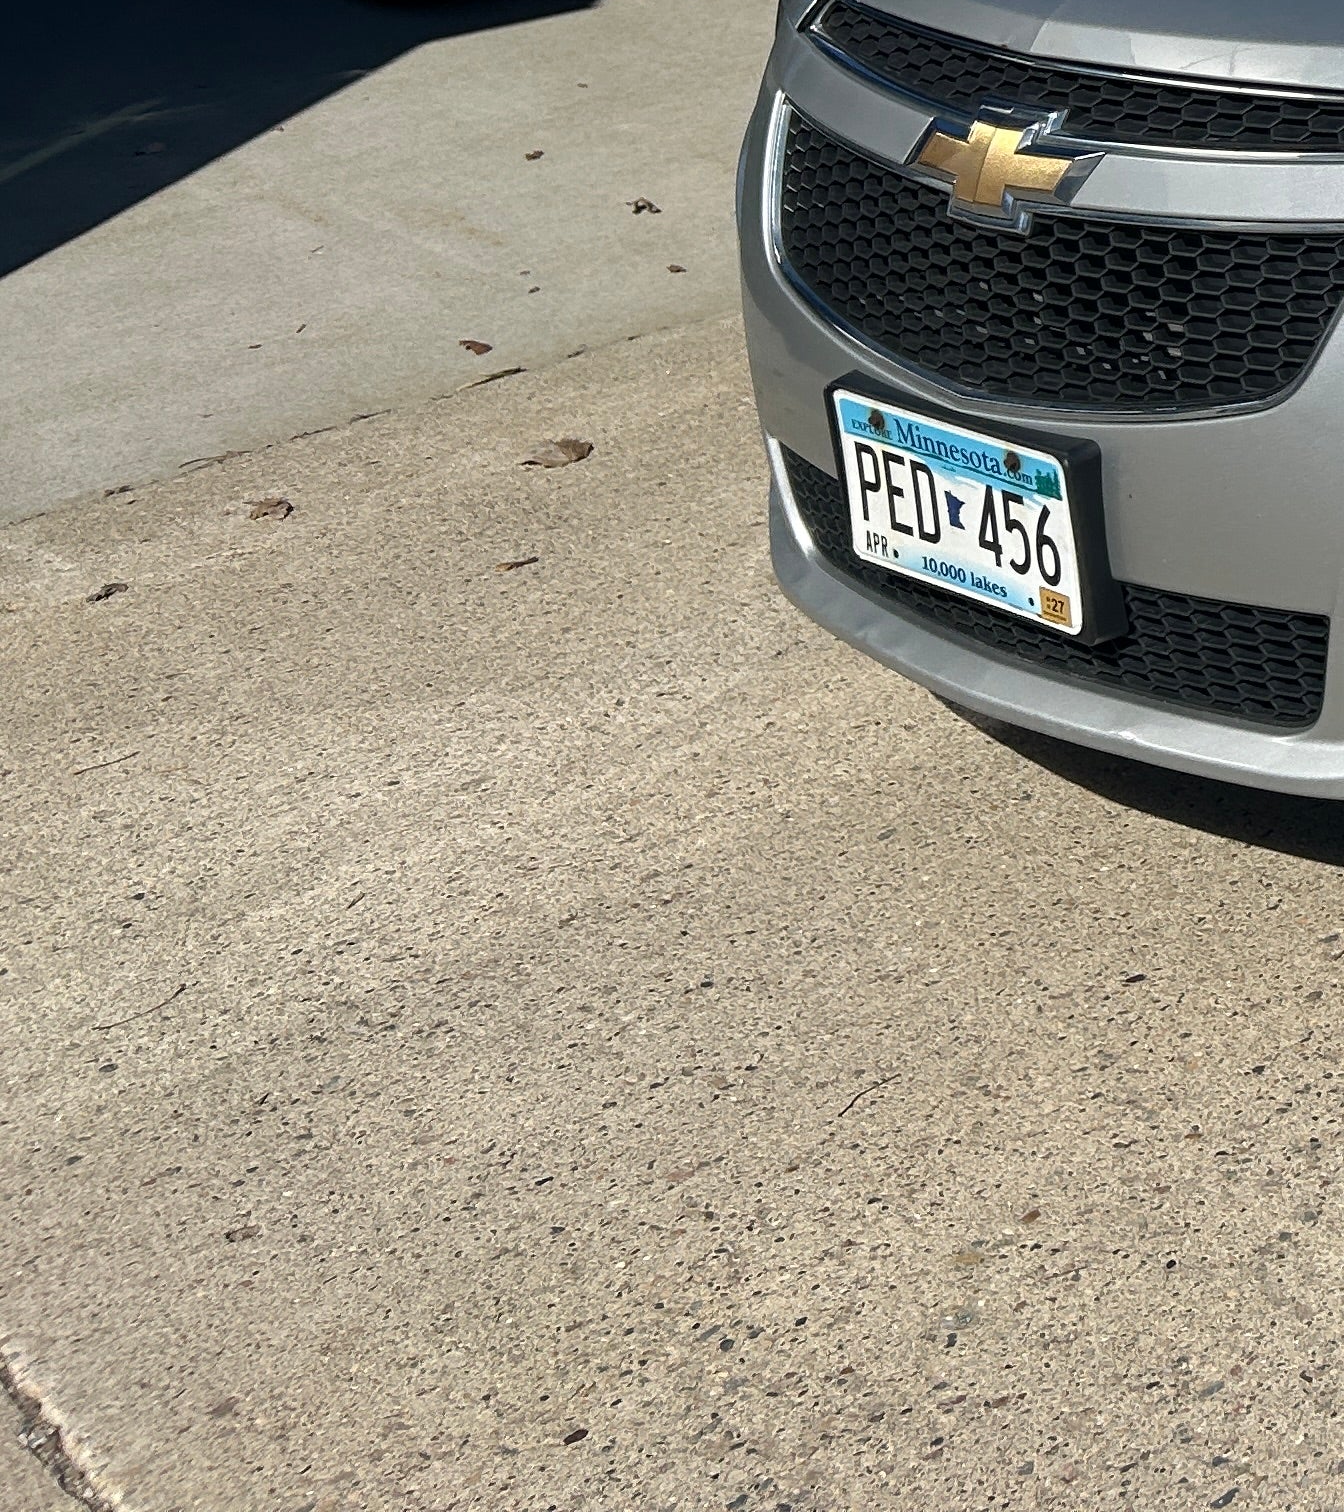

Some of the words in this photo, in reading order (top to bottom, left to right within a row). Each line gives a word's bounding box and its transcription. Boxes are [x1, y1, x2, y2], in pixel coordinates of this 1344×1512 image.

[854, 441, 941, 545] PED
[978, 483, 1062, 586] 456
[866, 530, 889, 558] APR
[922, 555, 967, 584] 10,000
[970, 571, 1008, 598] lakes
[1051, 598, 1065, 614] 27
